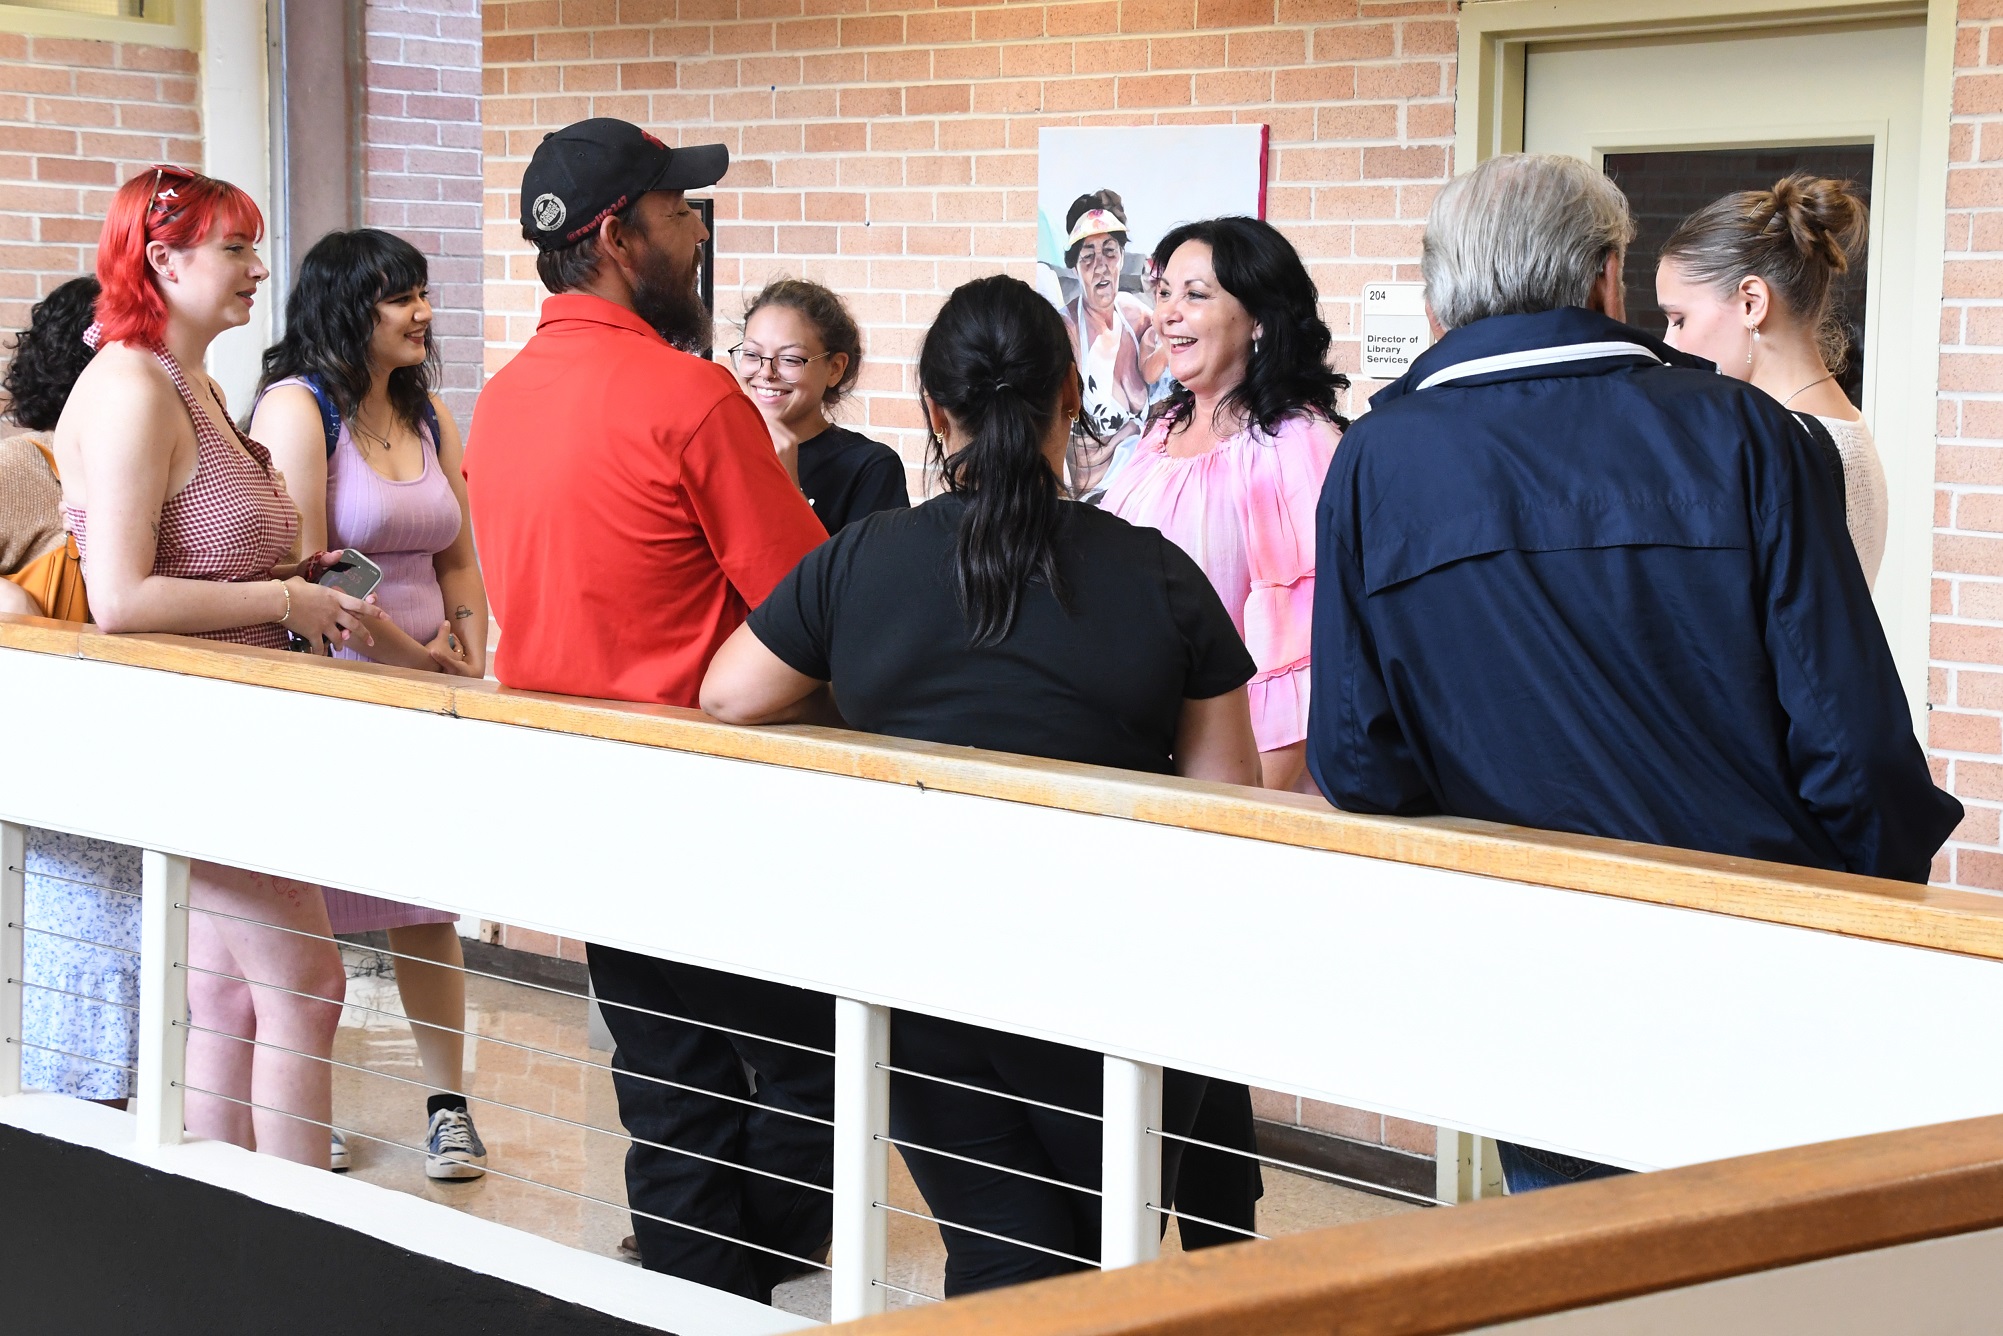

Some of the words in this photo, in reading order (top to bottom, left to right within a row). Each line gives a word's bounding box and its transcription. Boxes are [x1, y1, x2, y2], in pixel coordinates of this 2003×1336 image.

[1369, 290, 1386, 300] 204
[1367, 335, 1406, 343] Director
[1409, 335, 1419, 343] of
[1367, 345, 1401, 354] Library
[1366, 355, 1409, 364] Services
